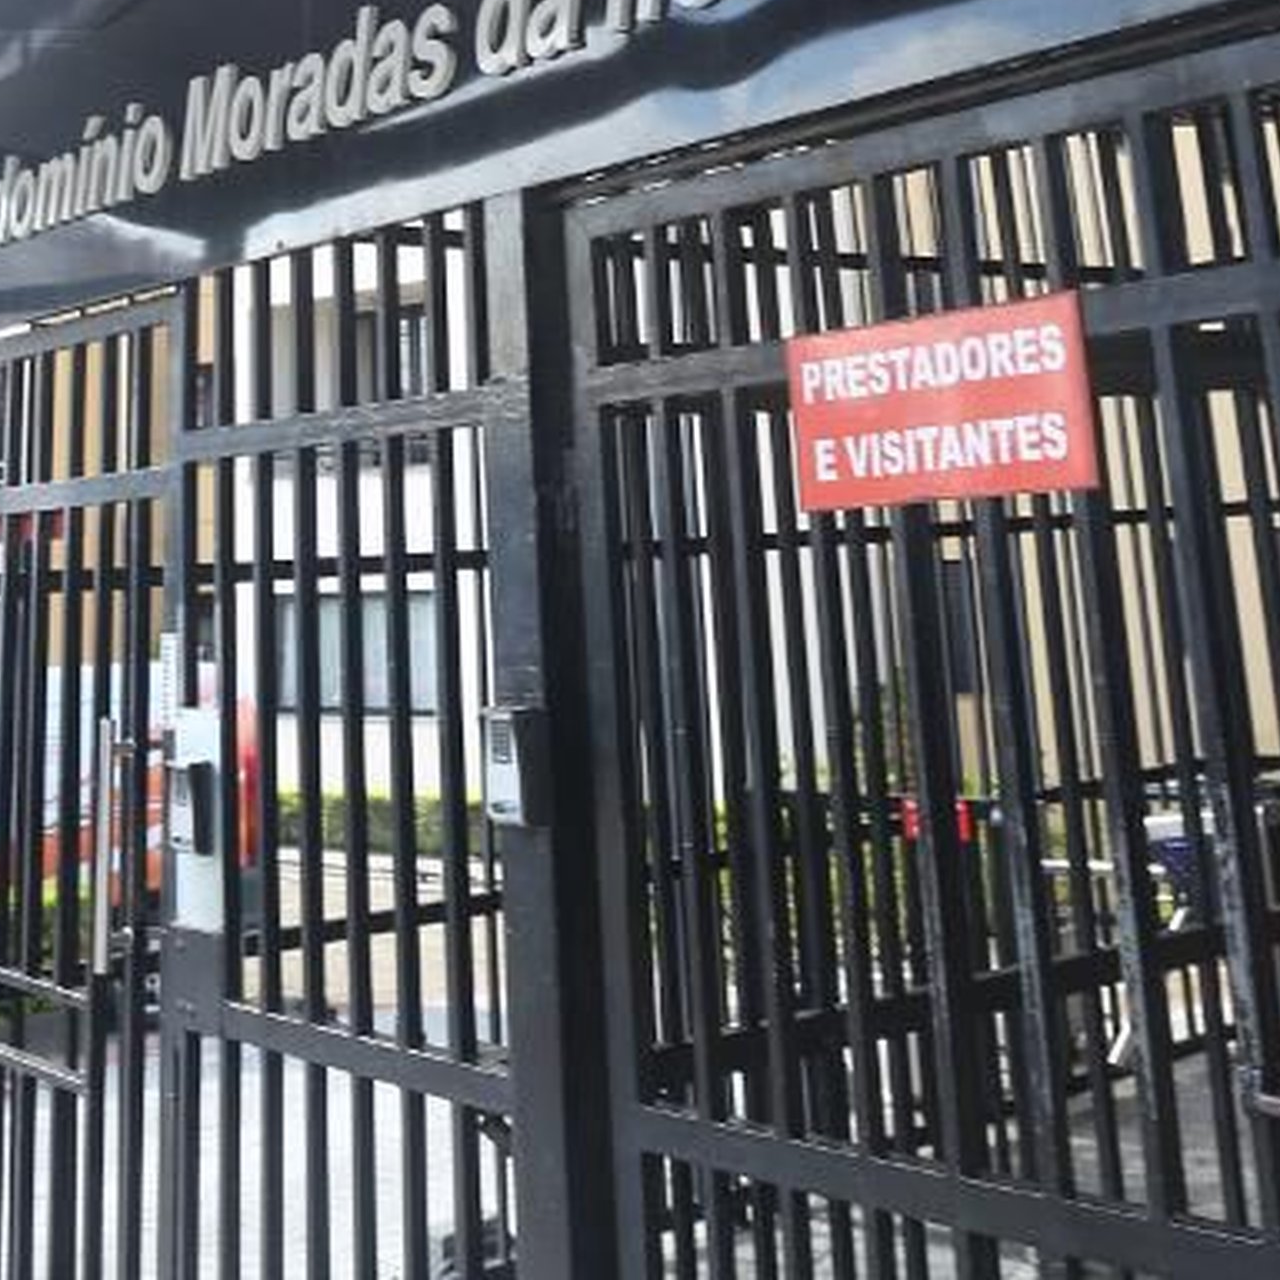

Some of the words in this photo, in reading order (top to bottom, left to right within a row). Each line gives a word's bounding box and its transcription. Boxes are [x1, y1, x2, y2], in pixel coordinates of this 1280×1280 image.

[180, 5, 458, 181] Moradas
[800, 325, 1067, 404] PRESTADORES
[814, 438, 839, 481] E
[844, 412, 1068, 478] VISITANTES
